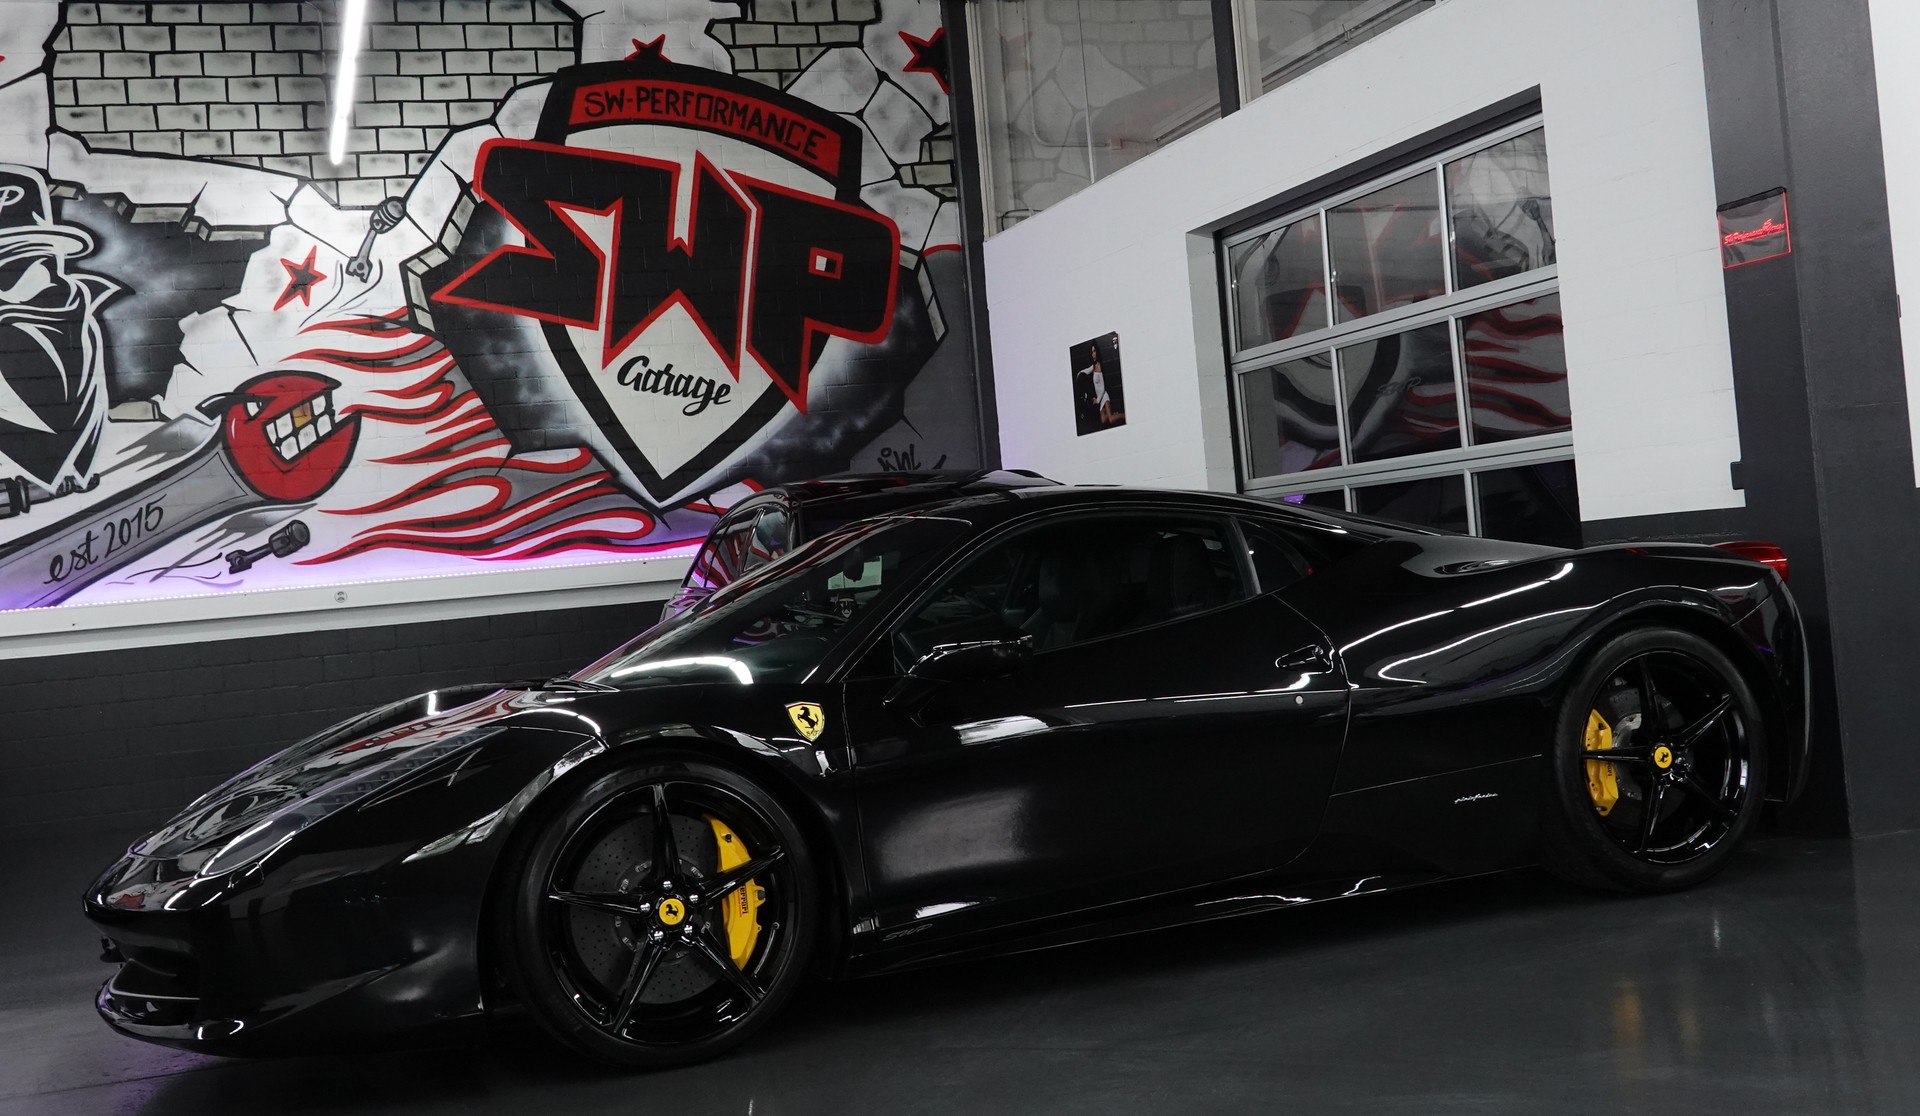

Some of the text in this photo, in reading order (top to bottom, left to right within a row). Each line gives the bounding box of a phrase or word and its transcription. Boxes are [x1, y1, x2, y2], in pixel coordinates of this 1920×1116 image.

[584, 85, 828, 160] SW-PERFORMANCE
[430, 137, 901, 416] SWP
[617, 355, 732, 416] Garage
[43, 493, 168, 585] est 2015
